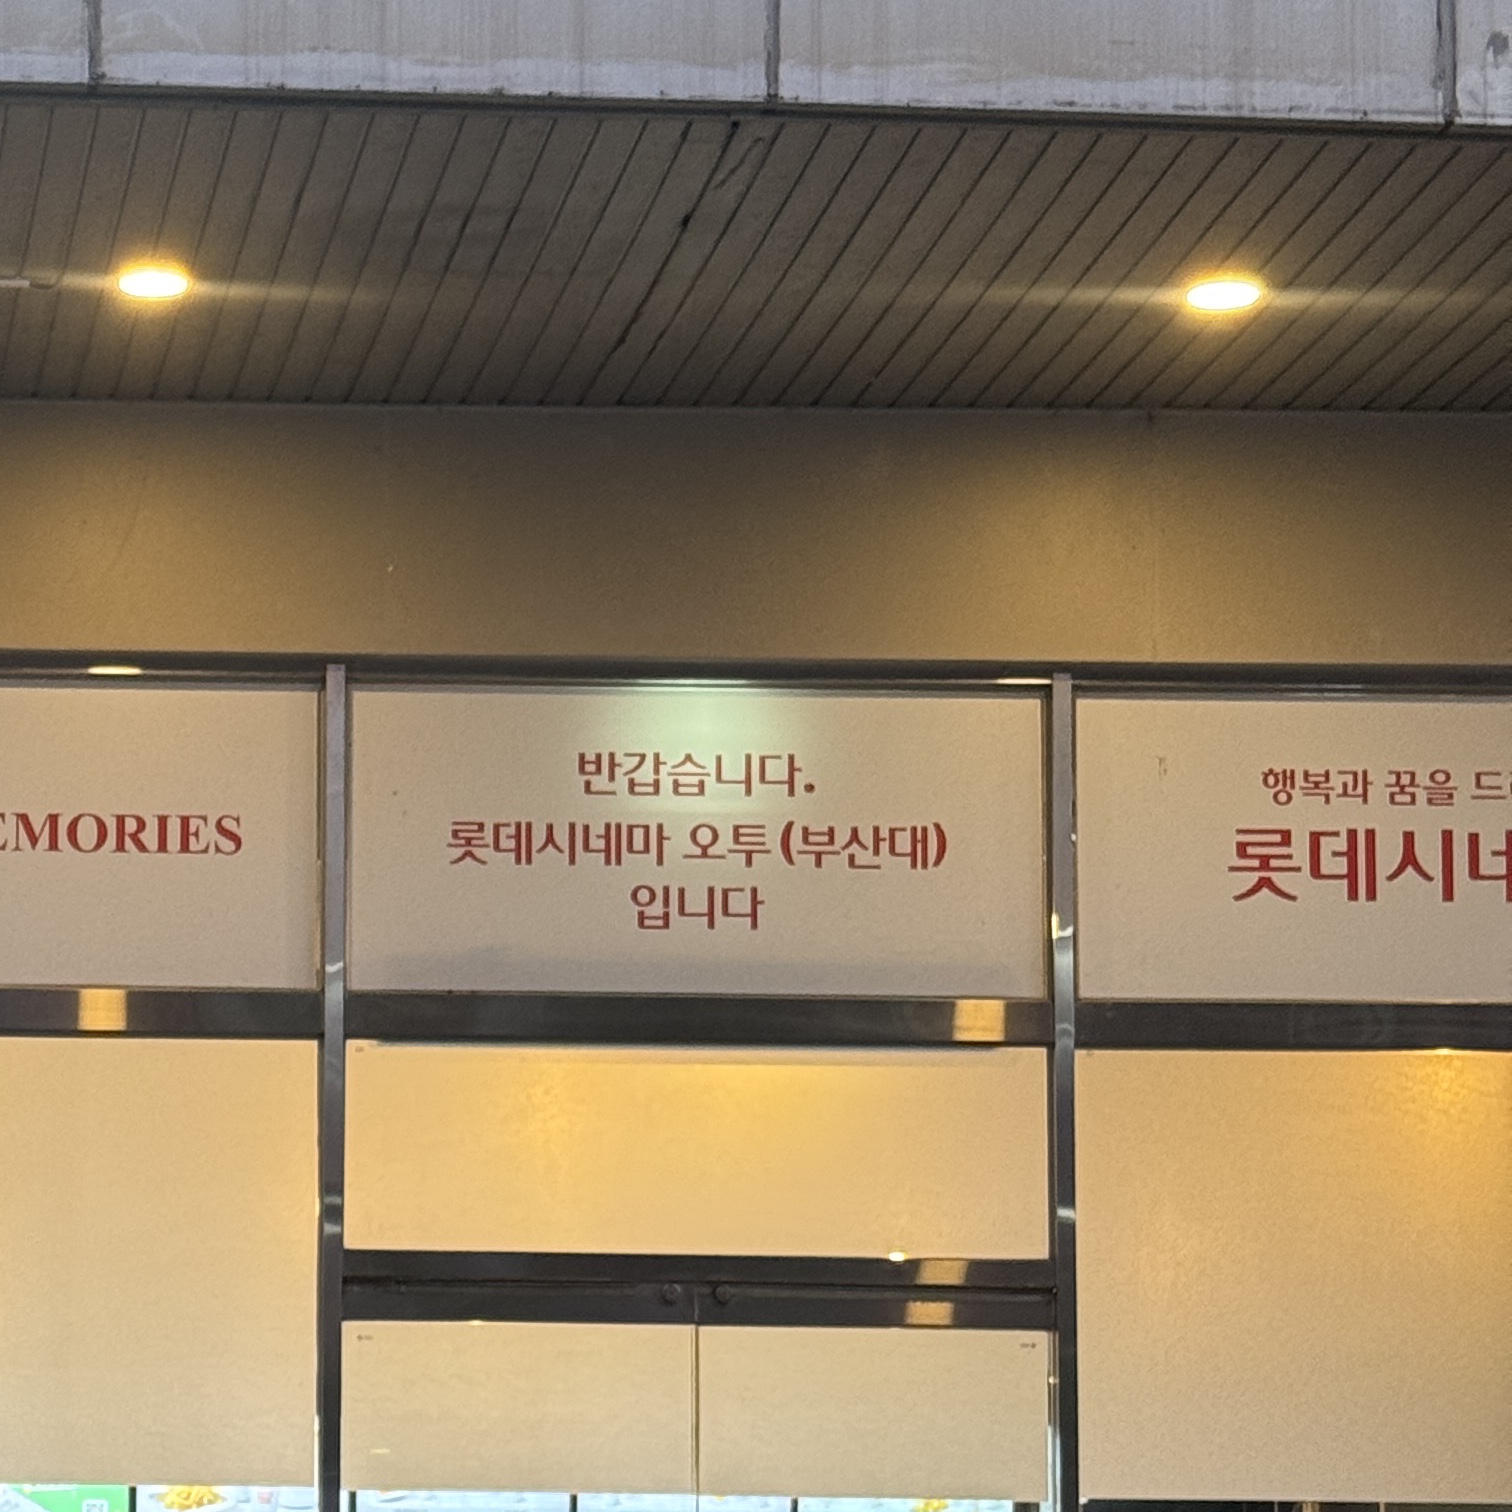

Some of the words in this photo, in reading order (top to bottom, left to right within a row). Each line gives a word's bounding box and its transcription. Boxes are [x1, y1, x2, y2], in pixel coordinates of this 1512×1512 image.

[577, 750, 816, 798] 반갑습니다.
[1260, 767, 1374, 807] 행복과
[1383, 768, 1459, 808] 꿈을
[1470, 770, 1512, 802] 드
[446, 819, 671, 869] 롯데시네마
[629, 884, 766, 931] 입니다
